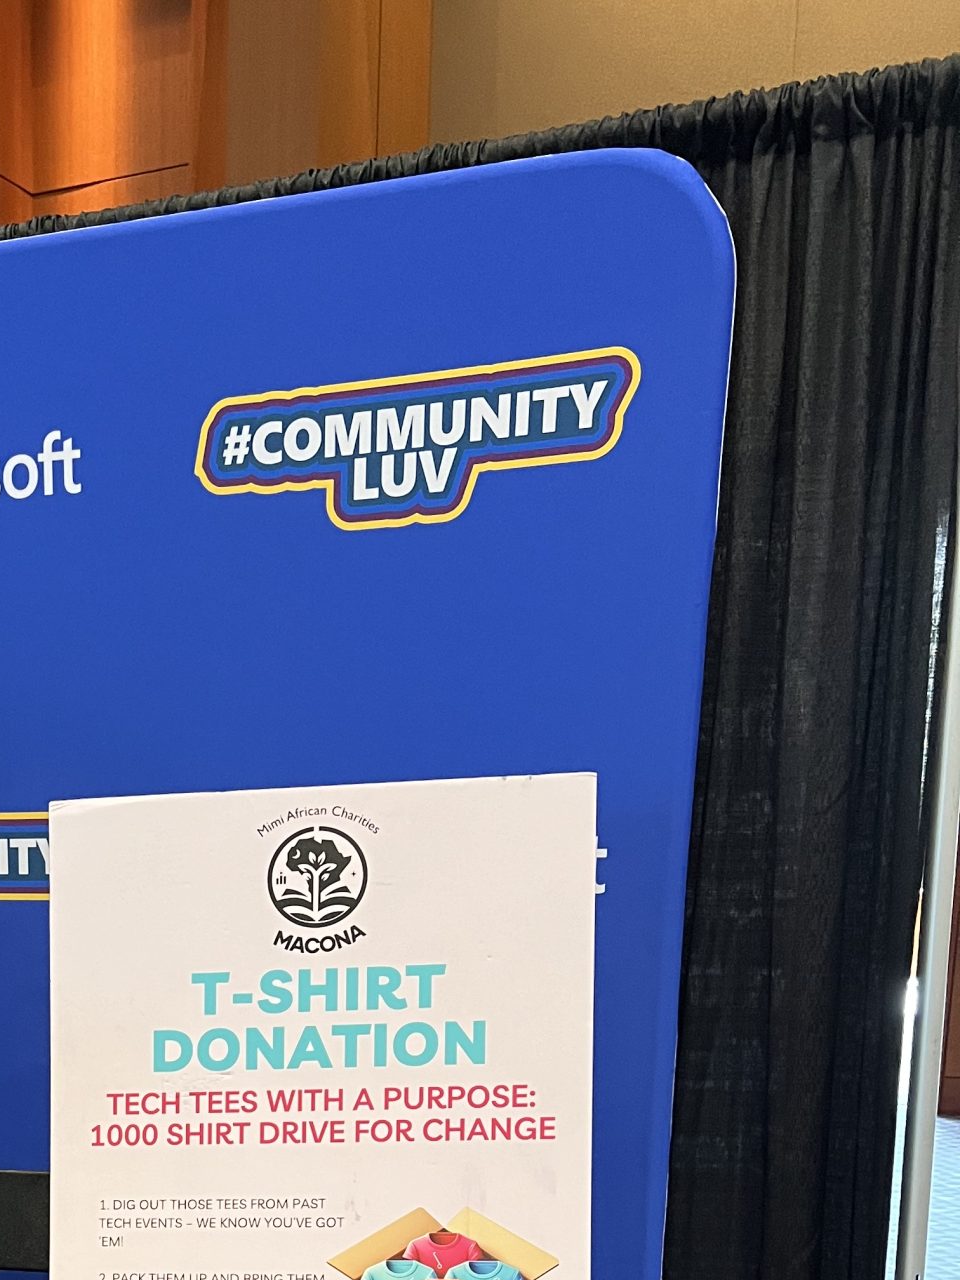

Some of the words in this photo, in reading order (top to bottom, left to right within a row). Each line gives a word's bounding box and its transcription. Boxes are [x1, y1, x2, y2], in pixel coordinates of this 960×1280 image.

[223, 380, 608, 466] #COMMUNITY
[352, 448, 458, 502] LUV
[257, 815, 285, 838] Mimi
[287, 806, 327, 822] African
[332, 806, 381, 835] Charities
[273, 925, 366, 954] MACONA
[191, 964, 446, 1015] T-SHIRT
[153, 1020, 486, 1073] DONATION
[107, 1092, 181, 1116] TECH
[189, 1090, 258, 1114] TEES
[267, 1088, 343, 1113] WITH
[353, 1088, 374, 1111] A
[385, 1085, 536, 1111] PURPOSE:
[91, 1123, 158, 1147] 1000
[167, 1123, 248, 1146] SHIRT
[259, 1121, 344, 1145] DRIVE
[355, 1120, 413, 1143] FOR
[423, 1116, 556, 1142] CHANGE
[100, 1200, 109, 1210] 1.
[113, 1199, 136, 1210] DIG
[140, 1199, 165, 1210] OUT
[170, 1199, 213, 1210] THOSE
[216, 1199, 247, 1210] TEES
[250, 1199, 288, 1209] FROM
[292, 1198, 326, 1209] PAST
[99, 1218, 131, 1229] TECH
[135, 1218, 183, 1229] EVENTS
[196, 1217, 216, 1228] WE
[220, 1217, 261, 1228] KNOW
[265, 1217, 312, 1228] YOU'VE
[316, 1217, 344, 1228] GOT
